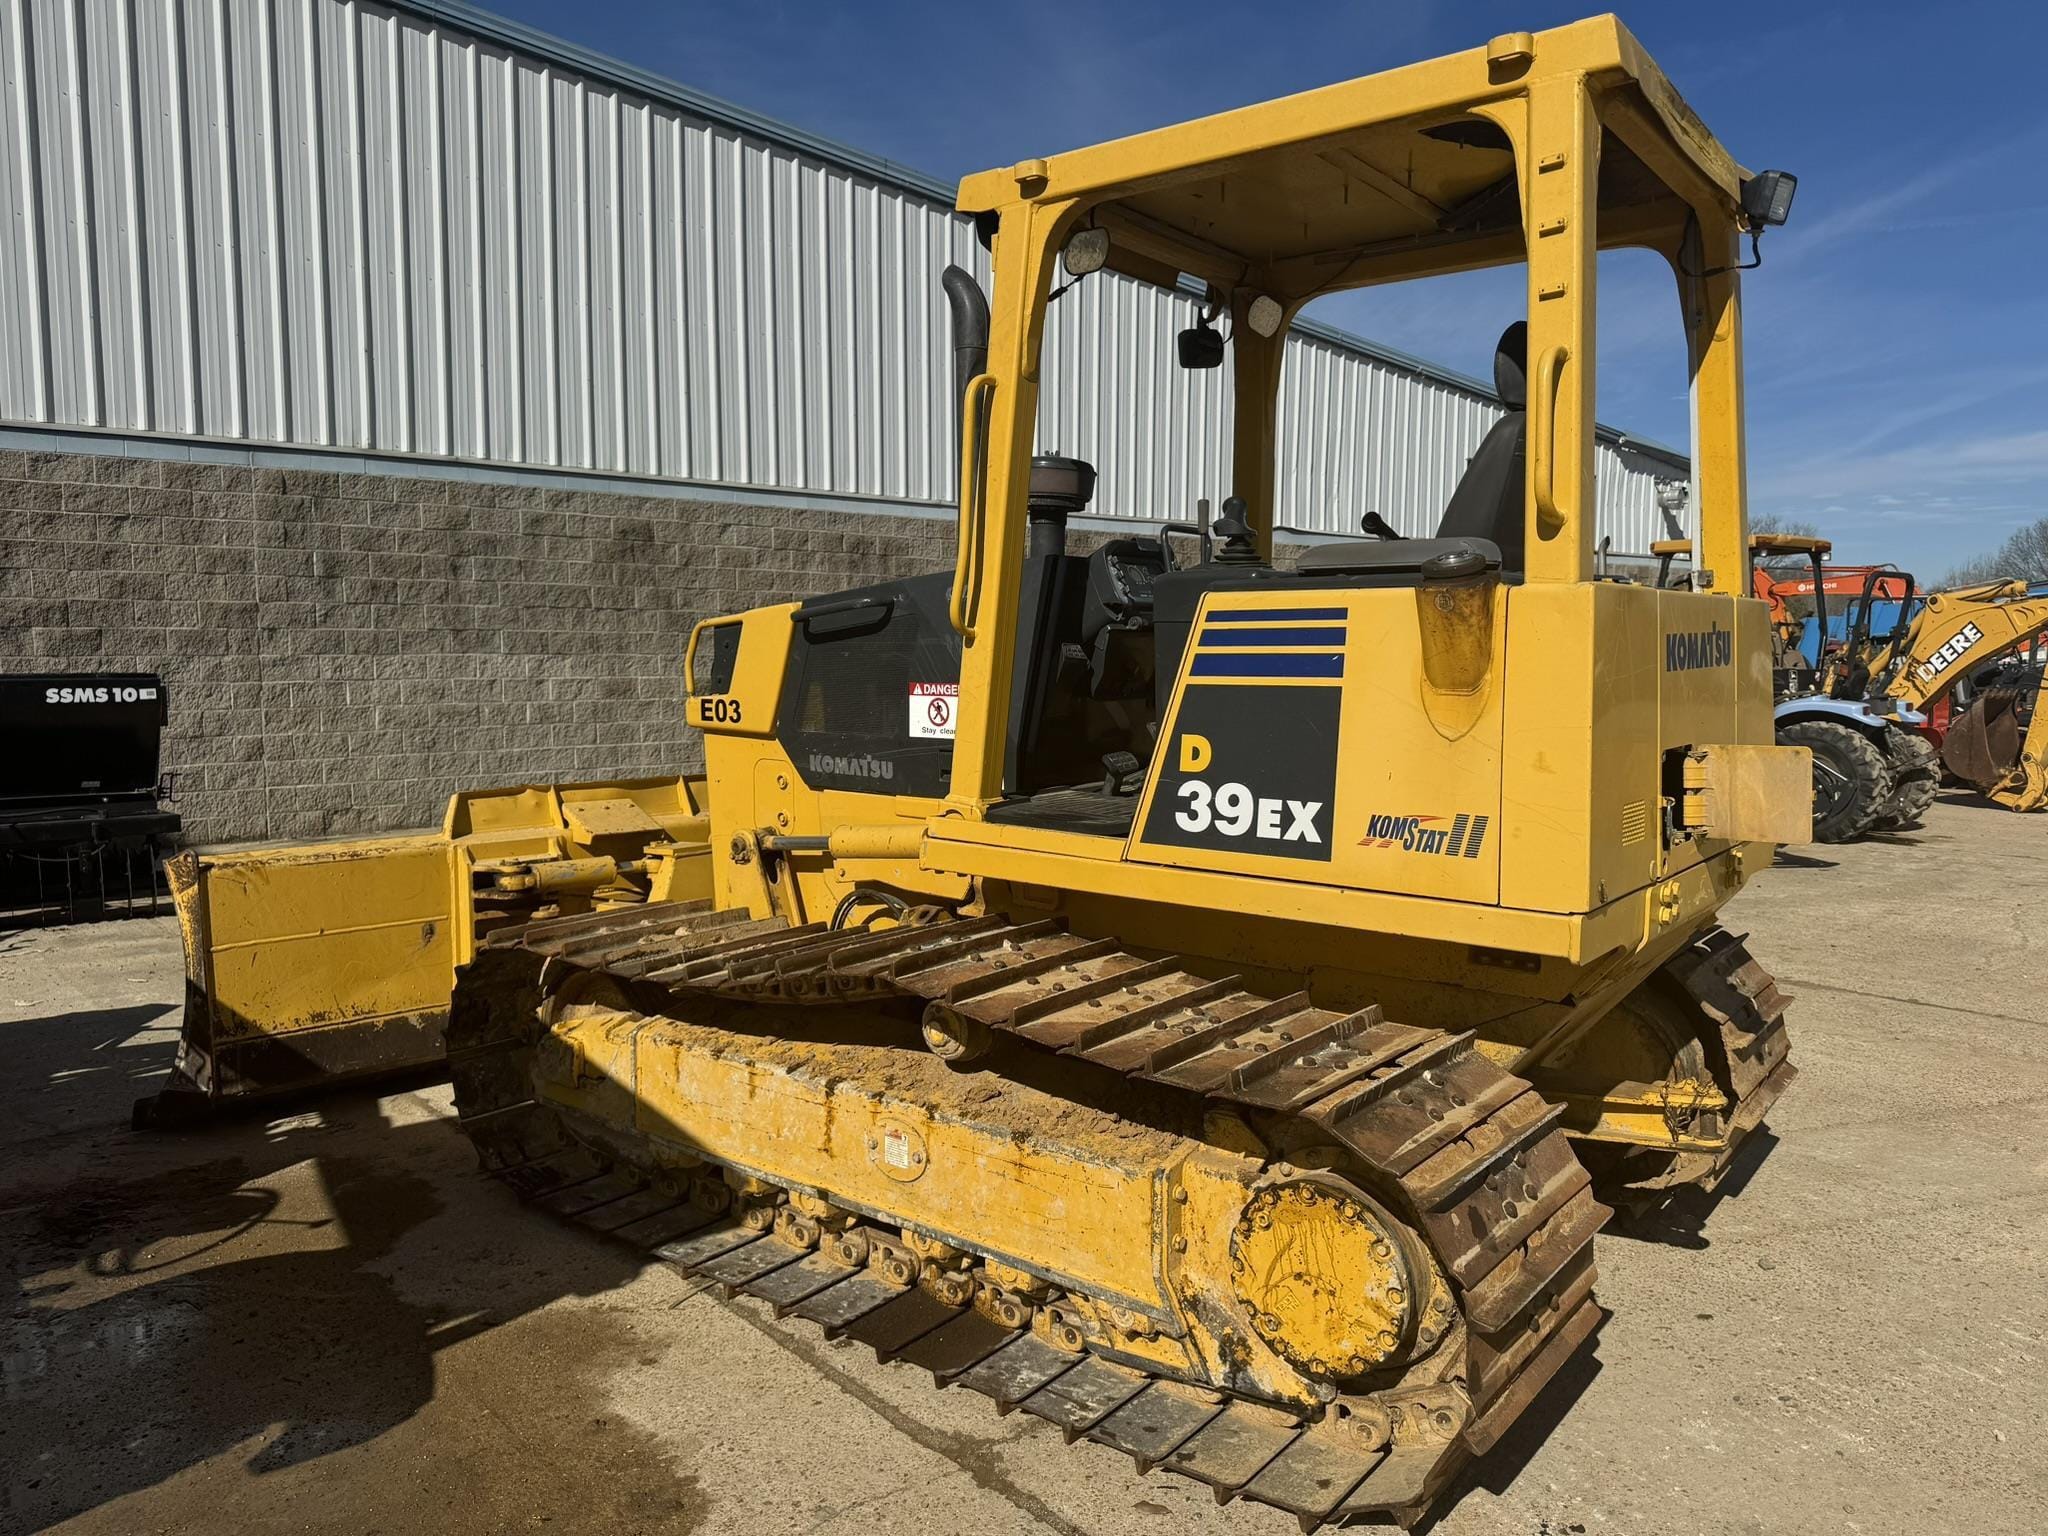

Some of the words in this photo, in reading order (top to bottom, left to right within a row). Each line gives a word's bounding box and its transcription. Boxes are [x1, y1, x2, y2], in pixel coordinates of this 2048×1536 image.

[1806, 582, 1838, 590] HICHI
[1666, 621, 1731, 672] KOMATSU
[1916, 622, 1984, 683] DEERE
[45, 687, 109, 703] SSMS
[700, 698, 742, 724] E03
[921, 726, 937, 735] Stay
[809, 753, 894, 780] KOMATSU
[1179, 733, 1212, 773] D
[1174, 780, 1324, 844] 39EX
